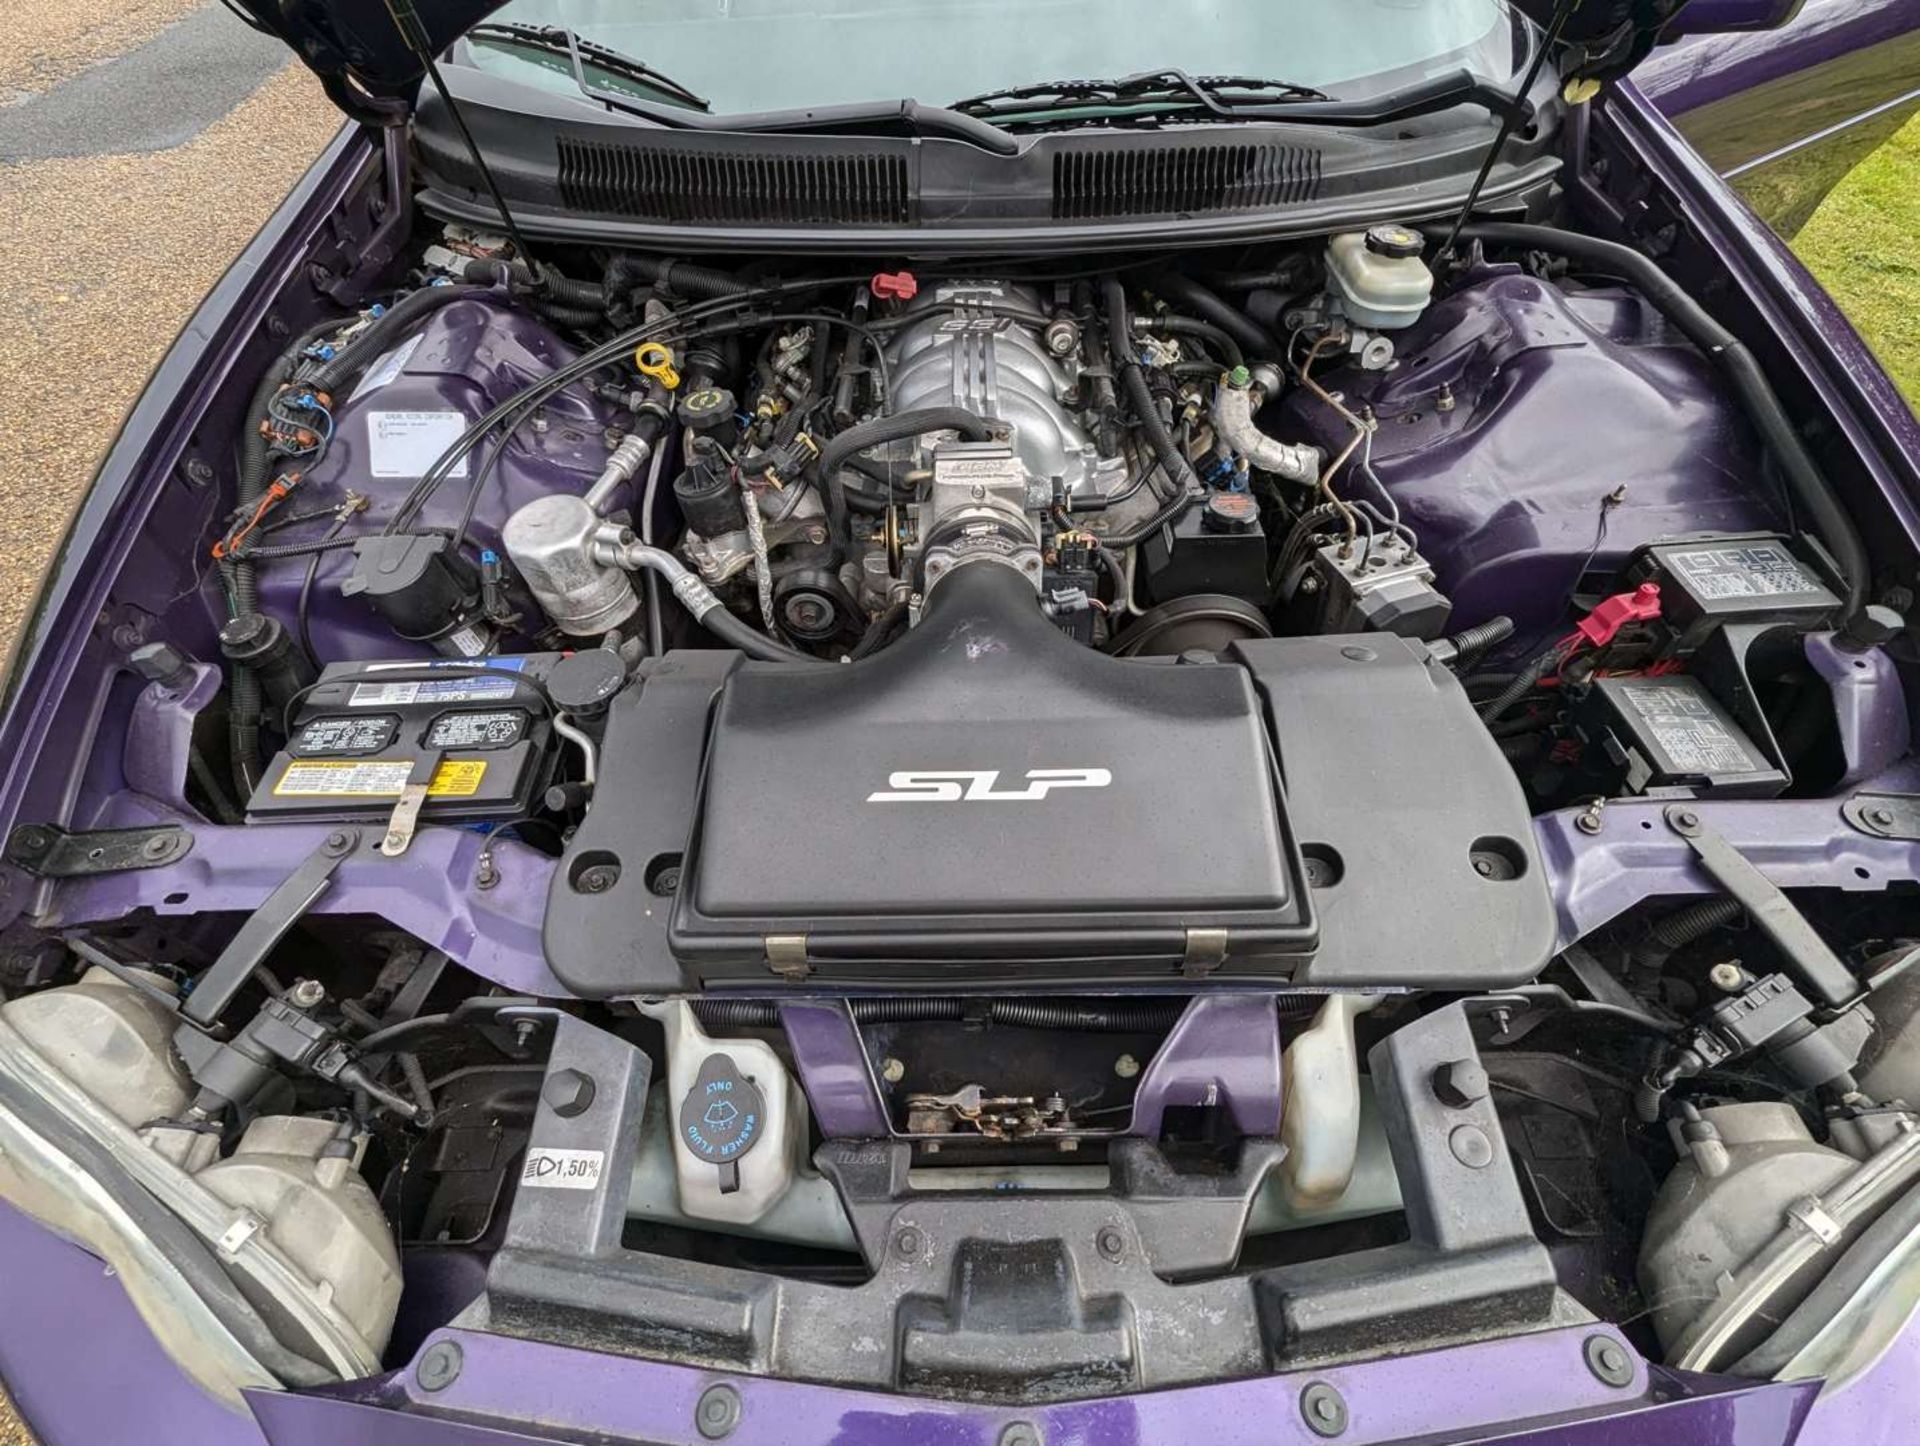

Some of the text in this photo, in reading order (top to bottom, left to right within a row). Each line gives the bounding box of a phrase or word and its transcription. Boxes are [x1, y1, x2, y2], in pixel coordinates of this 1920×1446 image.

[866, 768, 1112, 802] SLP
[706, 1081, 733, 1096] ONLY
[688, 1114, 755, 1155] WASHER FLUID
[557, 1158, 600, 1178] 1,50%
